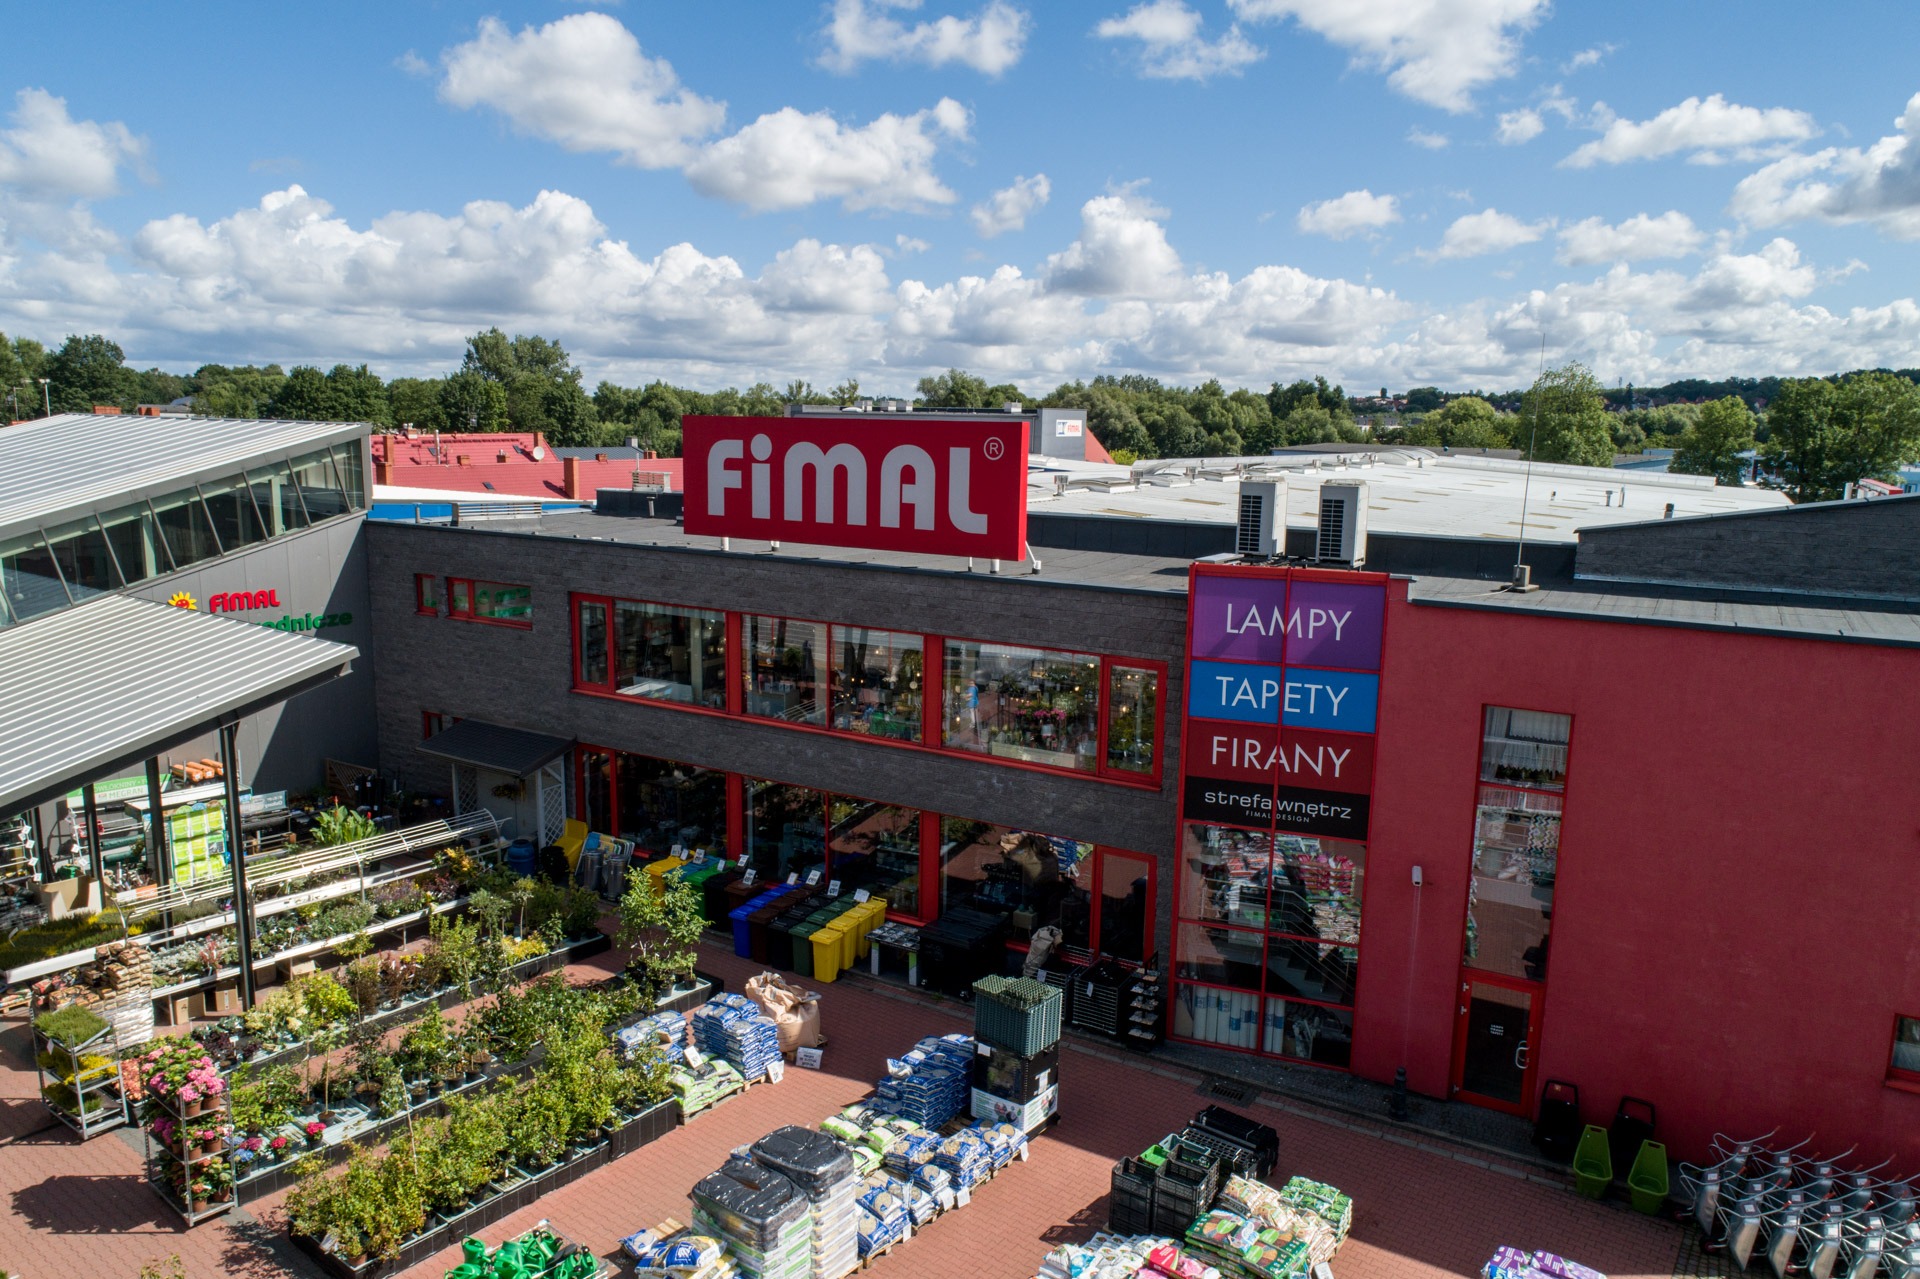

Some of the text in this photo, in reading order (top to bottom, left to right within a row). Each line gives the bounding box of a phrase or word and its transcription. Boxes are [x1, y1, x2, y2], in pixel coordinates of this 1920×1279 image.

[1226, 603, 1352, 641] LAMPY
[1215, 676, 1350, 717] TAPETY
[1212, 736, 1351, 777] FIRANY
[1204, 791, 1352, 820] strefa wnętrz
[1245, 810, 1310, 823] FIMAL DESIGN
